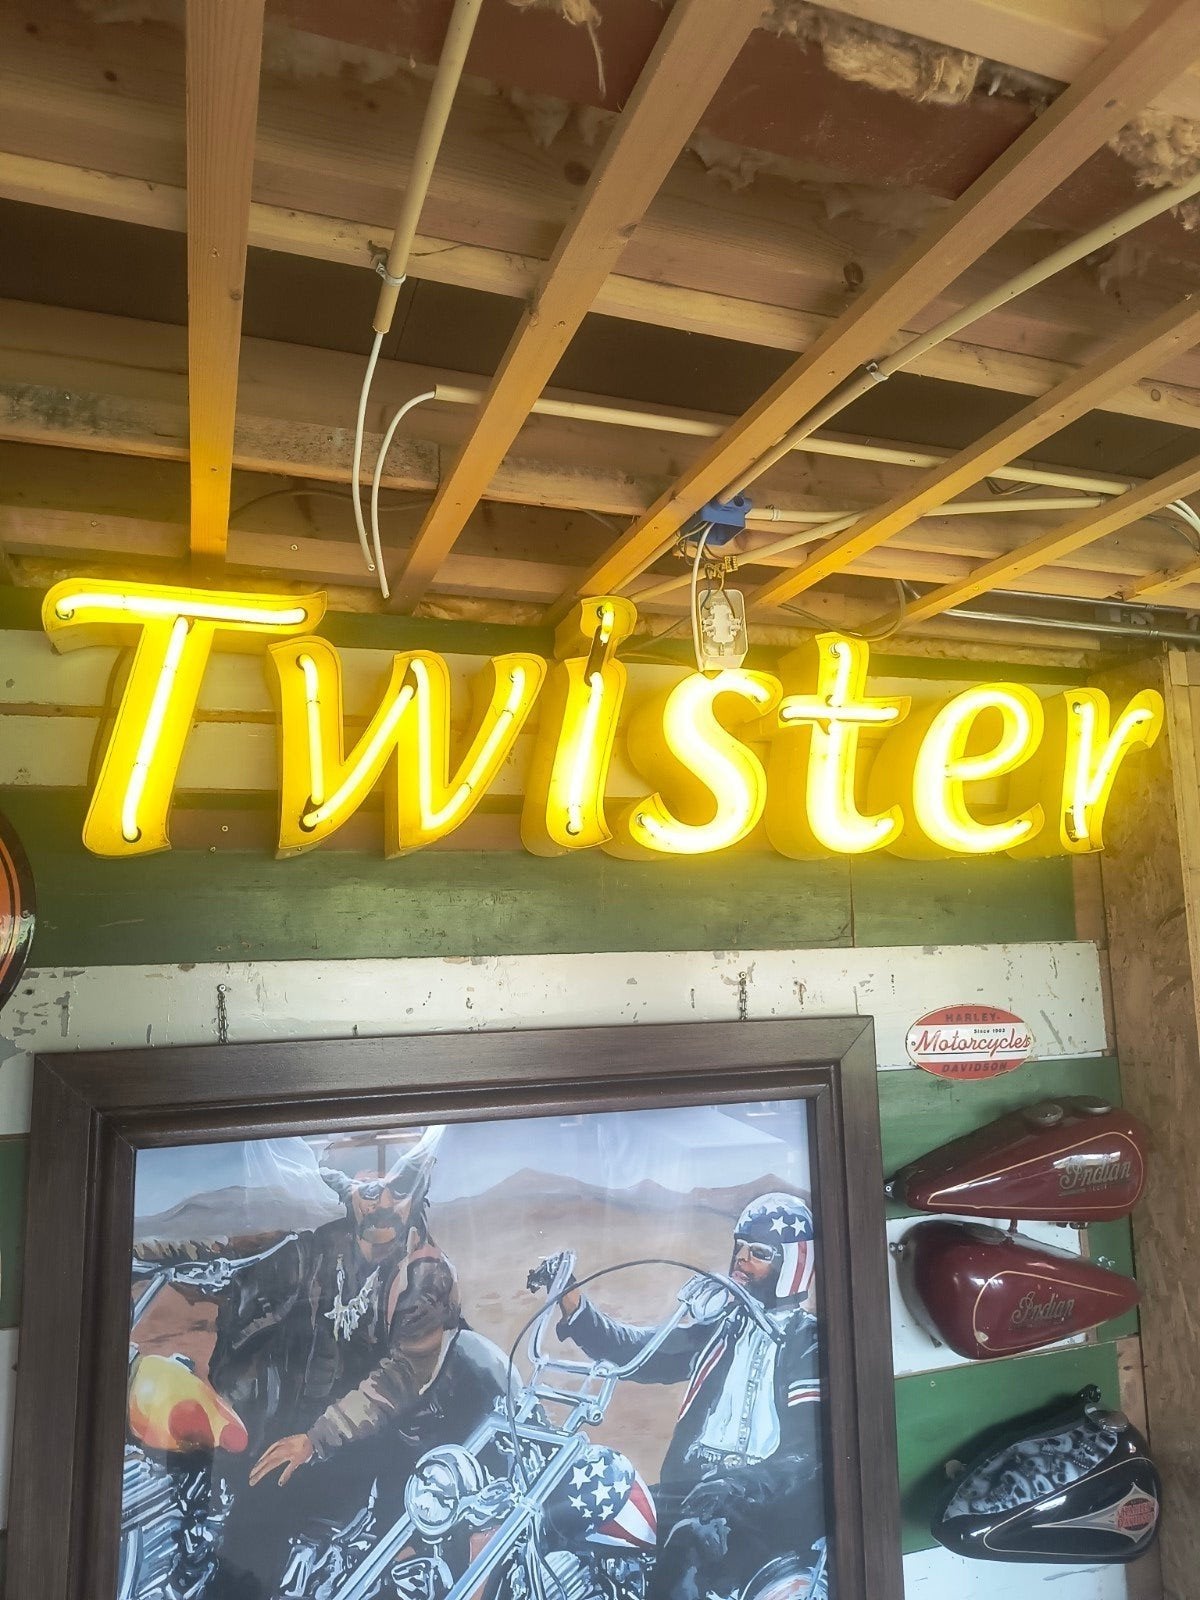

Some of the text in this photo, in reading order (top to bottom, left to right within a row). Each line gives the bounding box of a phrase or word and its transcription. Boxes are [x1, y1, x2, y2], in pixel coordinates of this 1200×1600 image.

[41, 576, 1165, 859] Twister
[913, 1027, 1031, 1058] Motorcycles
[941, 1061, 1008, 1073] DAVIDSON
[1059, 1159, 1131, 1190] Indian
[1011, 1290, 1075, 1324] Indian
